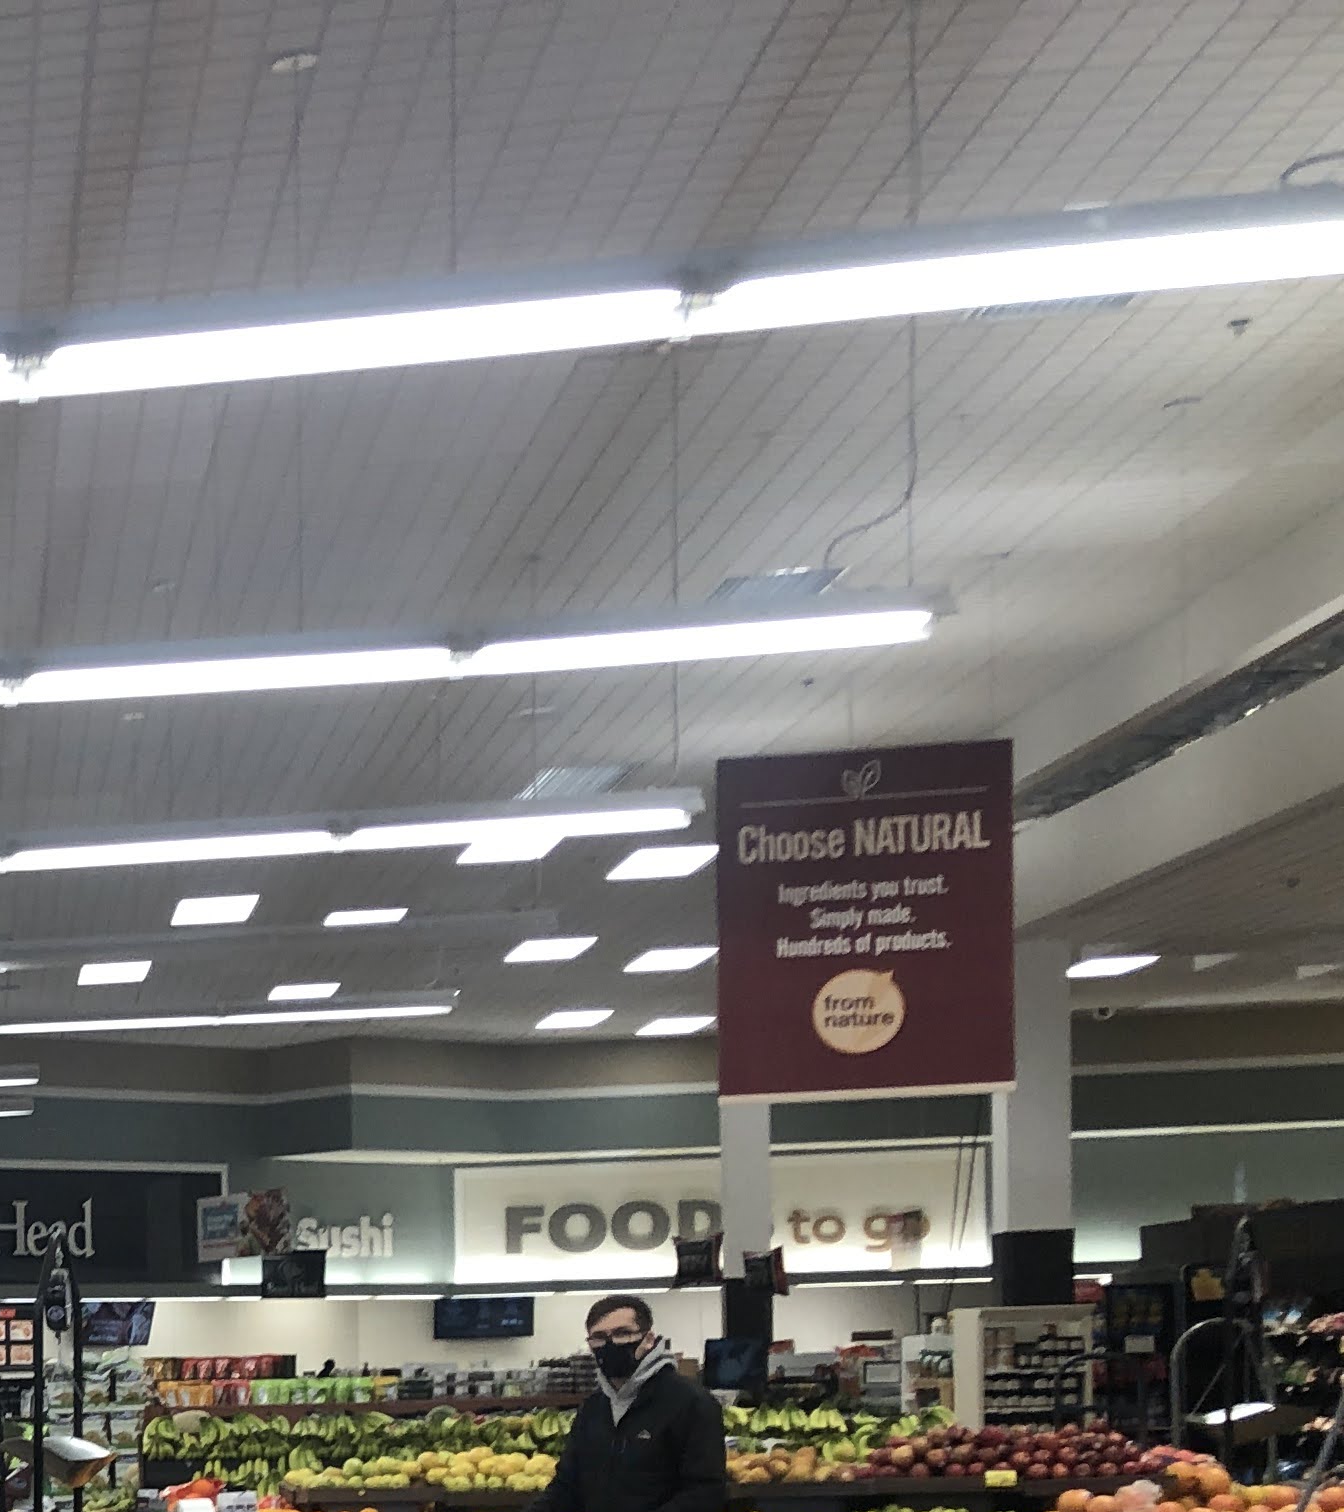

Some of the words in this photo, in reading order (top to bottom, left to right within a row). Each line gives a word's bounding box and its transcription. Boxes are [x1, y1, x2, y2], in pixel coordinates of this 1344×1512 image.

[737, 823, 845, 865] Choose
[853, 810, 991, 857] NATURAL
[778, 881, 868, 907] Ingredients
[871, 882, 899, 901] you
[903, 873, 949, 895] trust.
[809, 907, 862, 930] Simply
[868, 904, 917, 924] made.
[776, 937, 852, 958] Hundreds
[855, 935, 872, 953] of
[875, 929, 951, 956] products.
[824, 993, 876, 1012] from
[824, 1010, 895, 1029] nature
[296, 1212, 394, 1258] Sushi
[505, 1199, 723, 1254] FOOD
[787, 1207, 846, 1246] to
